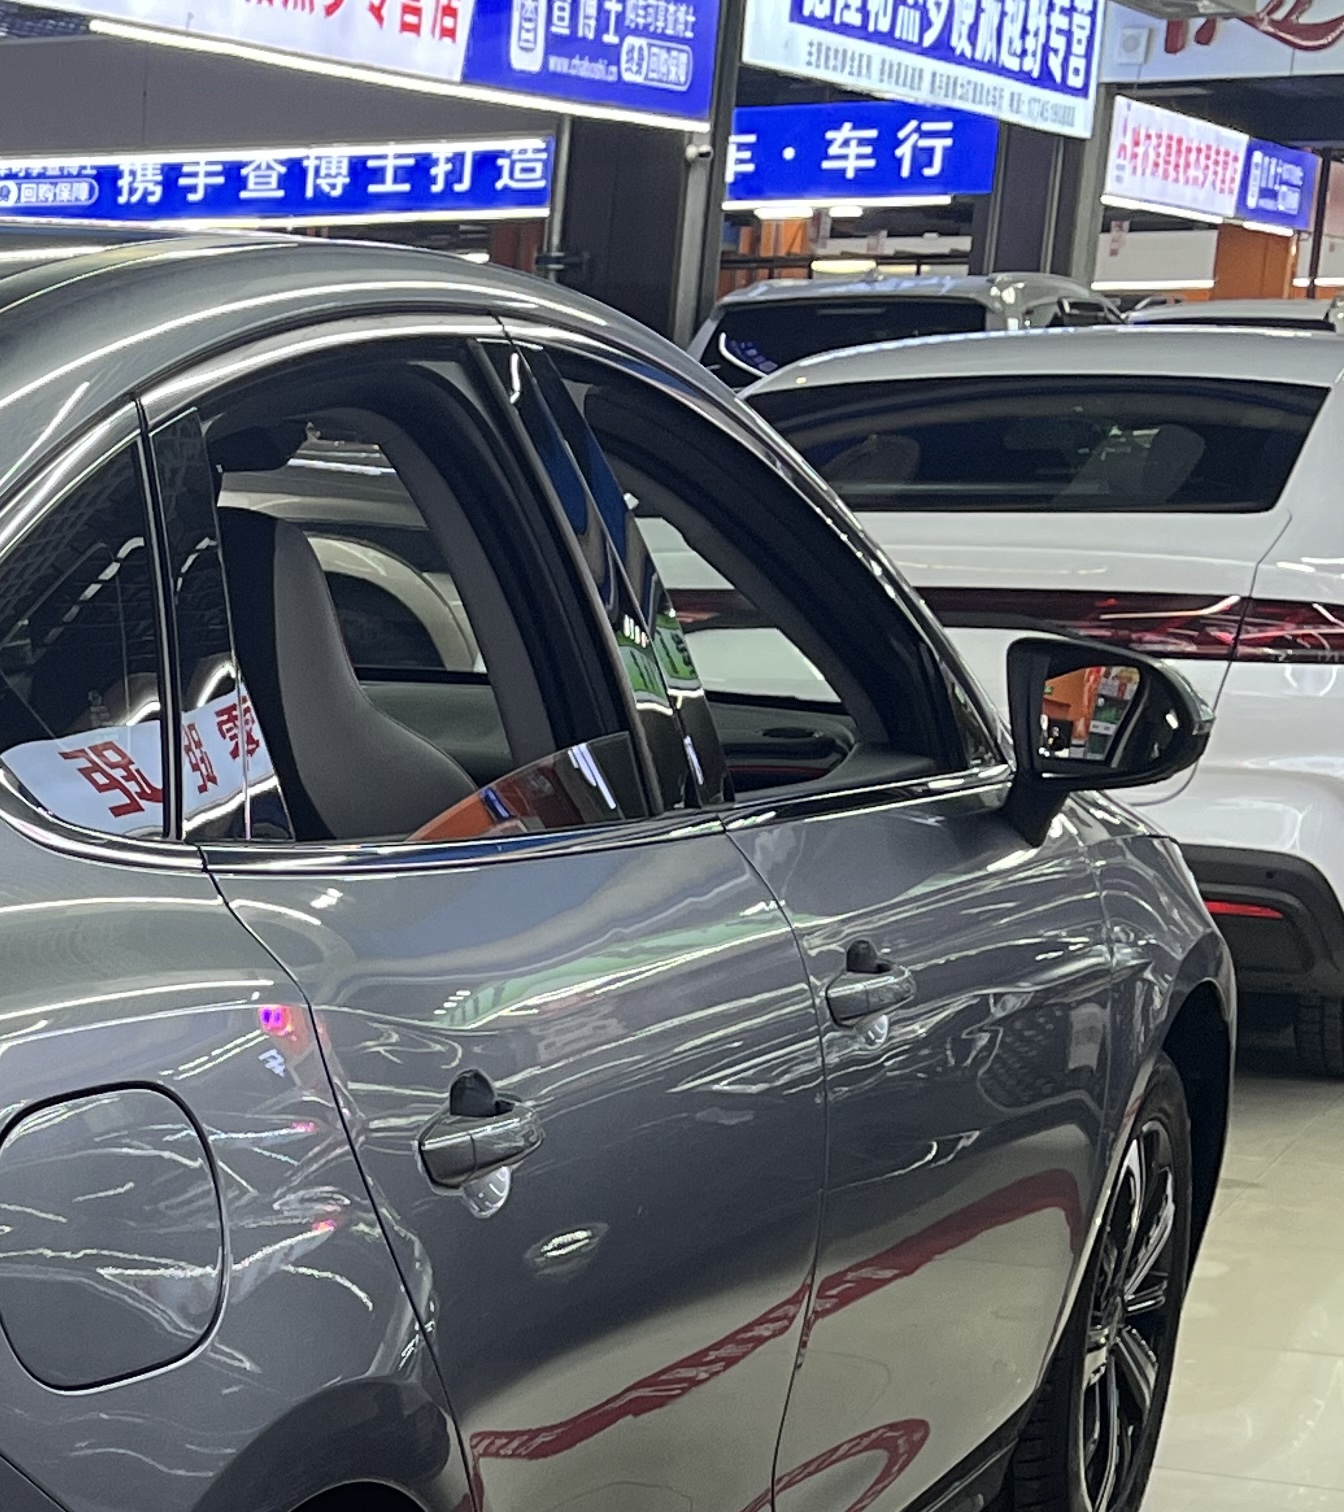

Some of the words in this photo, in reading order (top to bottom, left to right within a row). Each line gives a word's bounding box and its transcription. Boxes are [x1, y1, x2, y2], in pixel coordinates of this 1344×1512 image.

[118, 144, 548, 205] 携手查博士打造
